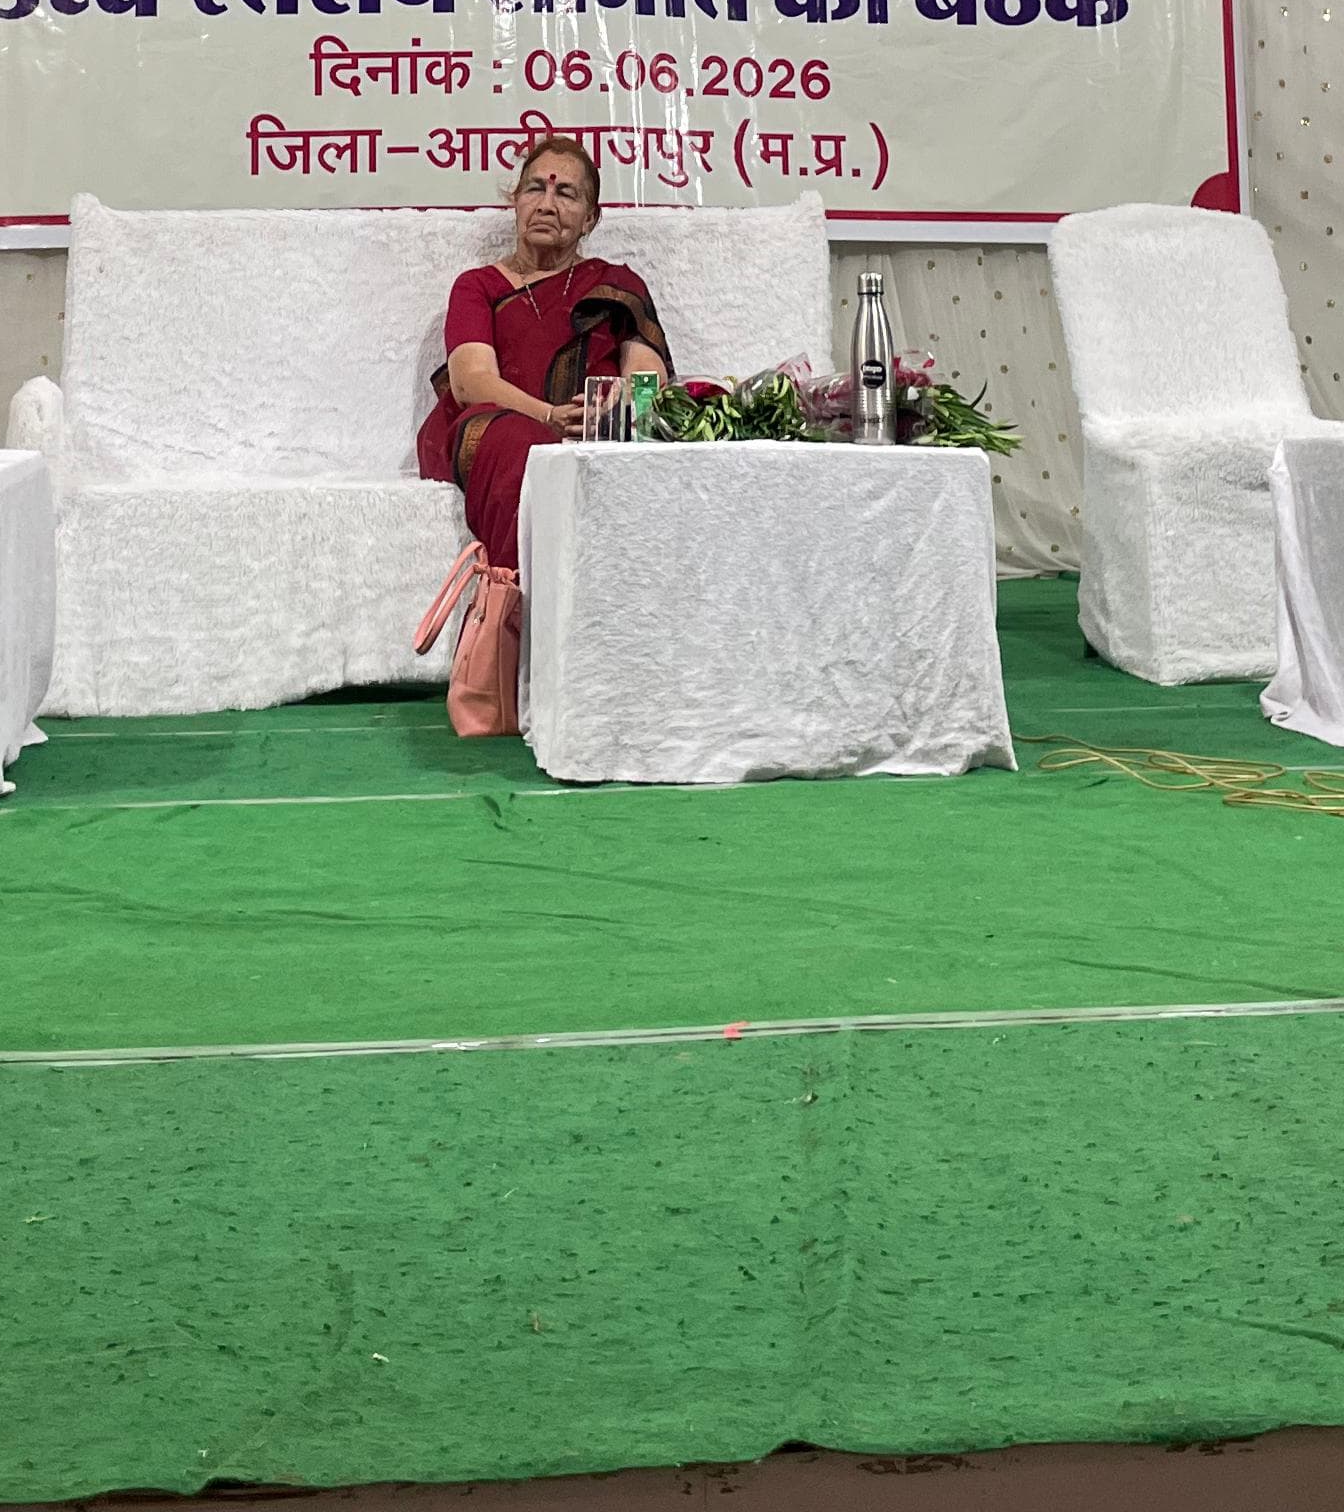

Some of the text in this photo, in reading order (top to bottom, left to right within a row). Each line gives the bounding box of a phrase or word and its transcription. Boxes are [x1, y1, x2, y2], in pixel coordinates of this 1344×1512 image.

[309, 35, 473, 97] दिनांक
[524, 49, 831, 100] 06.06.2026
[734, 119, 889, 191] (म.प्र.)
